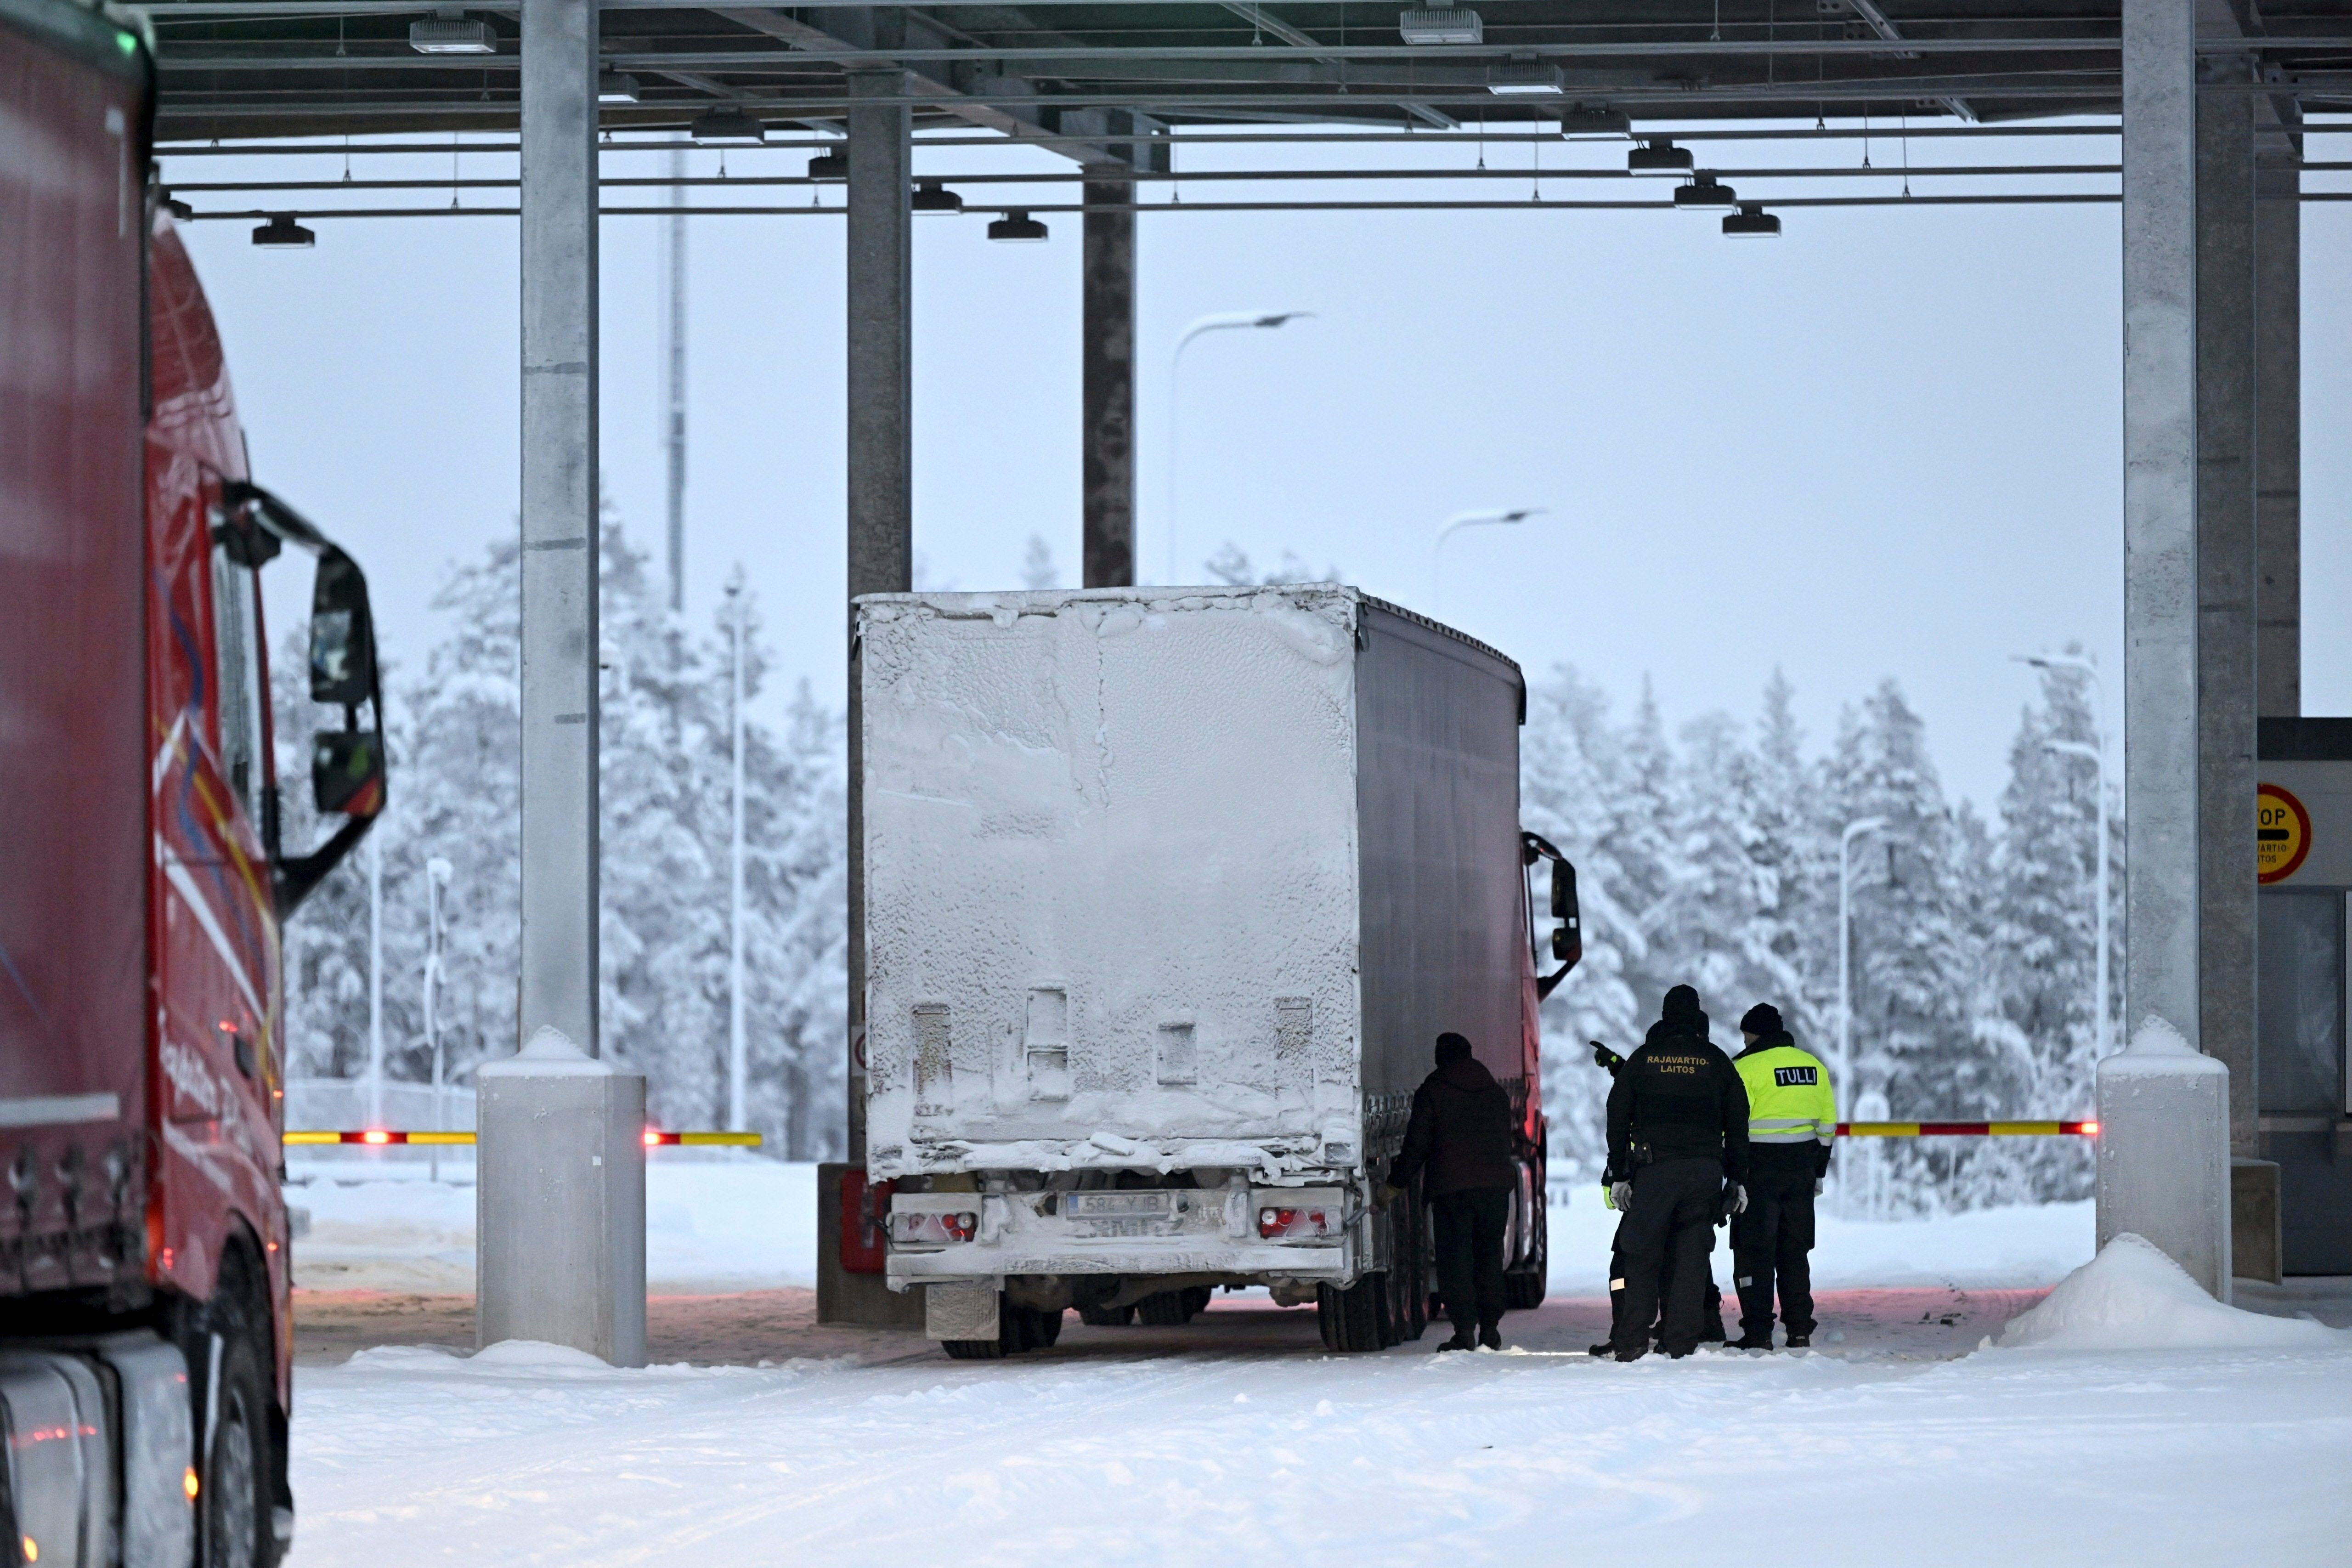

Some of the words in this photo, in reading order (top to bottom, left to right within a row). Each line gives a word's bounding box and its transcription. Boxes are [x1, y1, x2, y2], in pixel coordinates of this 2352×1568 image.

[2258, 809, 2286, 826] OP
[1647, 1056, 1709, 1065] RAJAVARTIO-
[1661, 1065, 1695, 1074] LAITOS
[1775, 1069, 1816, 1085] TULLI
